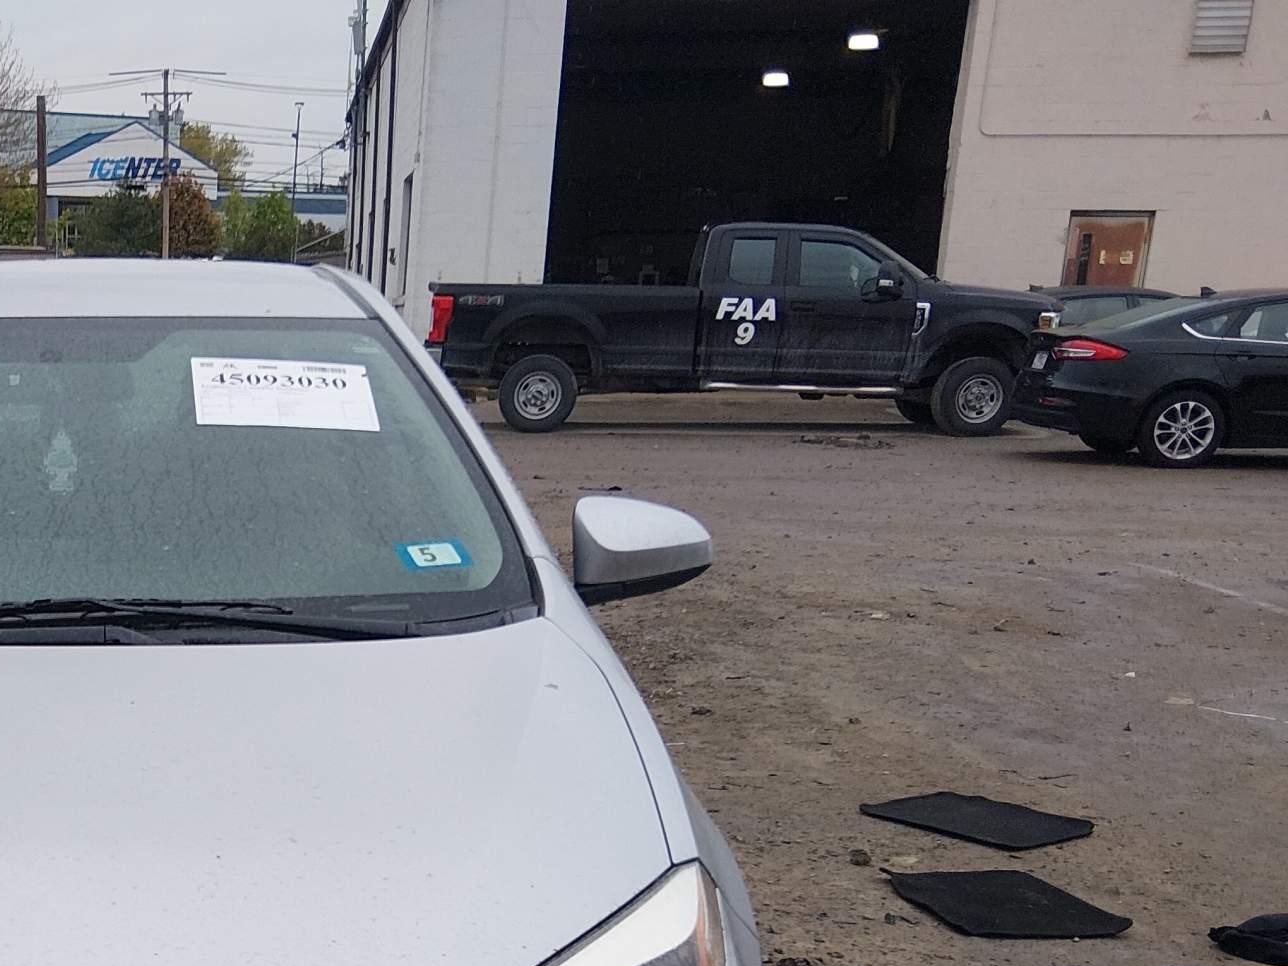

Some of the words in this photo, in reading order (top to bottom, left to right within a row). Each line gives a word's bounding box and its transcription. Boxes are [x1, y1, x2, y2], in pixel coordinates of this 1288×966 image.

[89, 156, 182, 181] ICENTER
[715, 297, 776, 321] FAA
[734, 322, 755, 345] 9
[212, 372, 347, 391] 45093030
[418, 547, 437, 562] 5
